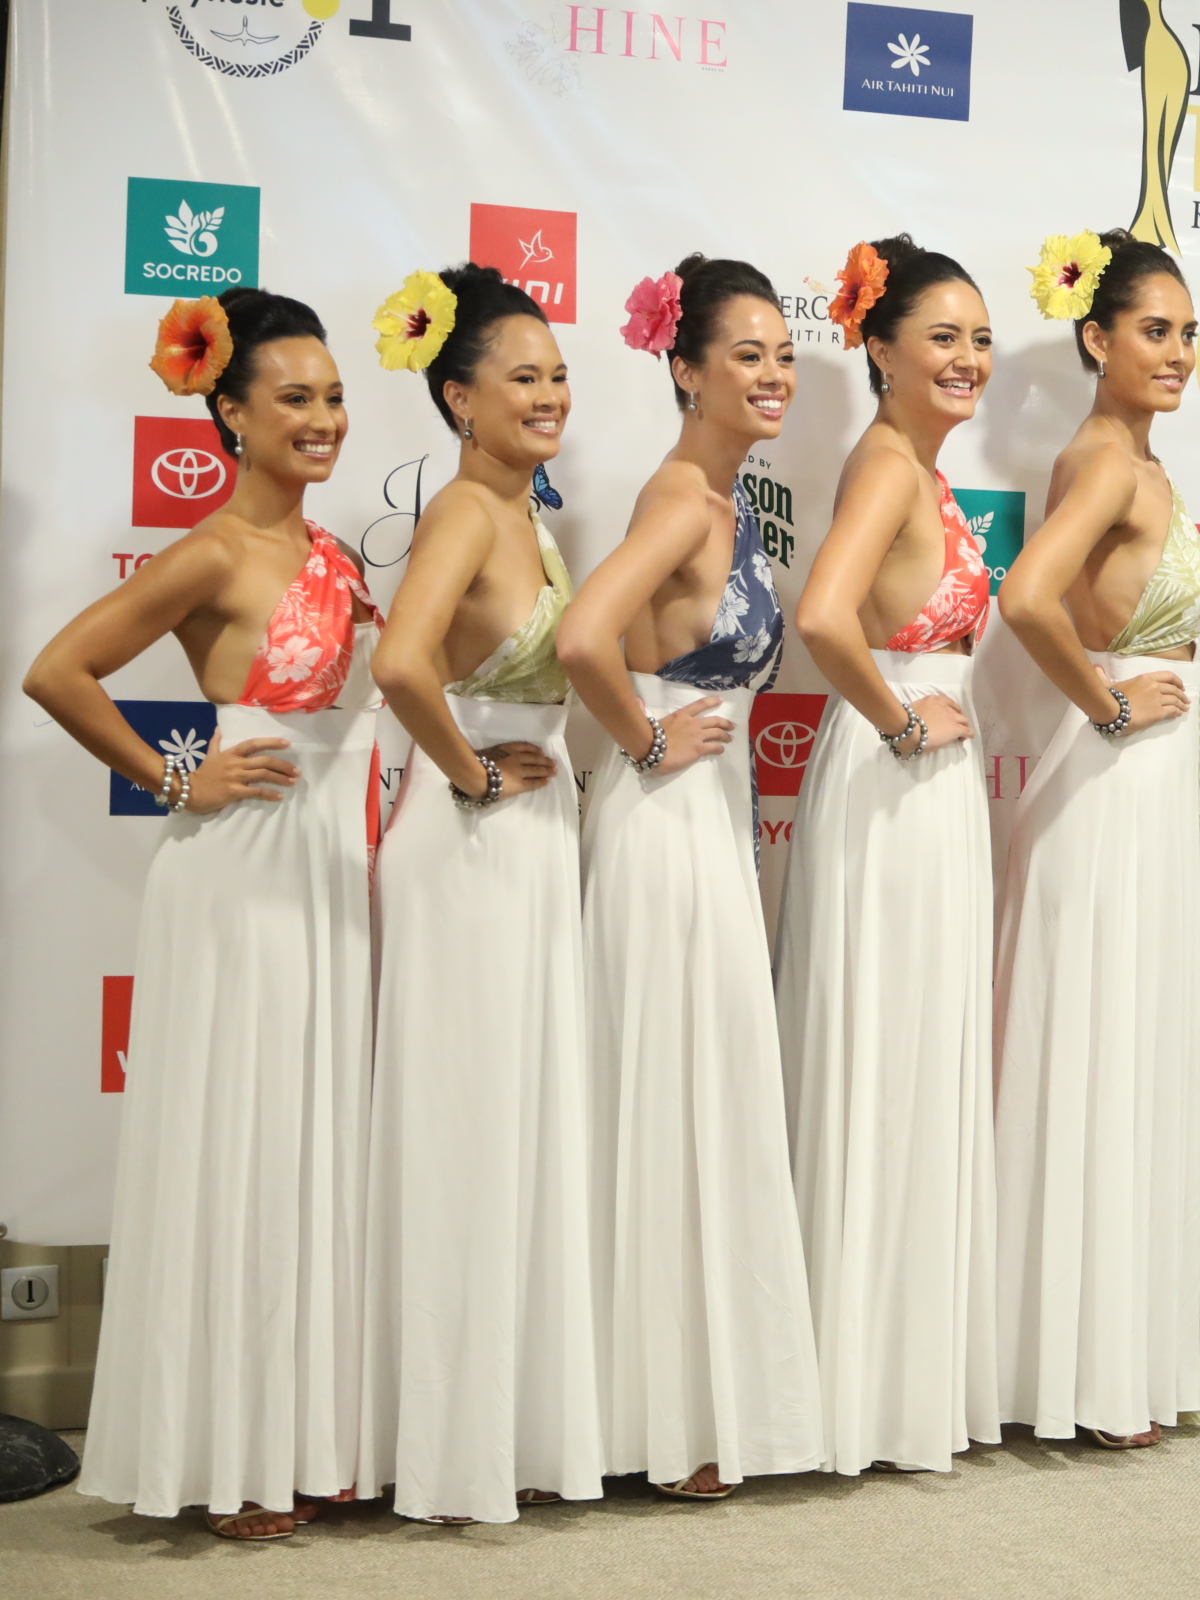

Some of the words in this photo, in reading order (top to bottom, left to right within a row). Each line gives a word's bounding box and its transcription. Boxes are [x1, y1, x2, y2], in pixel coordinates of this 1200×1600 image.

[564, 5, 728, 67] HINE
[861, 79, 885, 91] AIR
[886, 81, 928, 94] TAHITI
[931, 85, 954, 97] NUI
[142, 262, 242, 283] SOCREDO
[759, 459, 771, 470] BY
[742, 473, 794, 527] son
